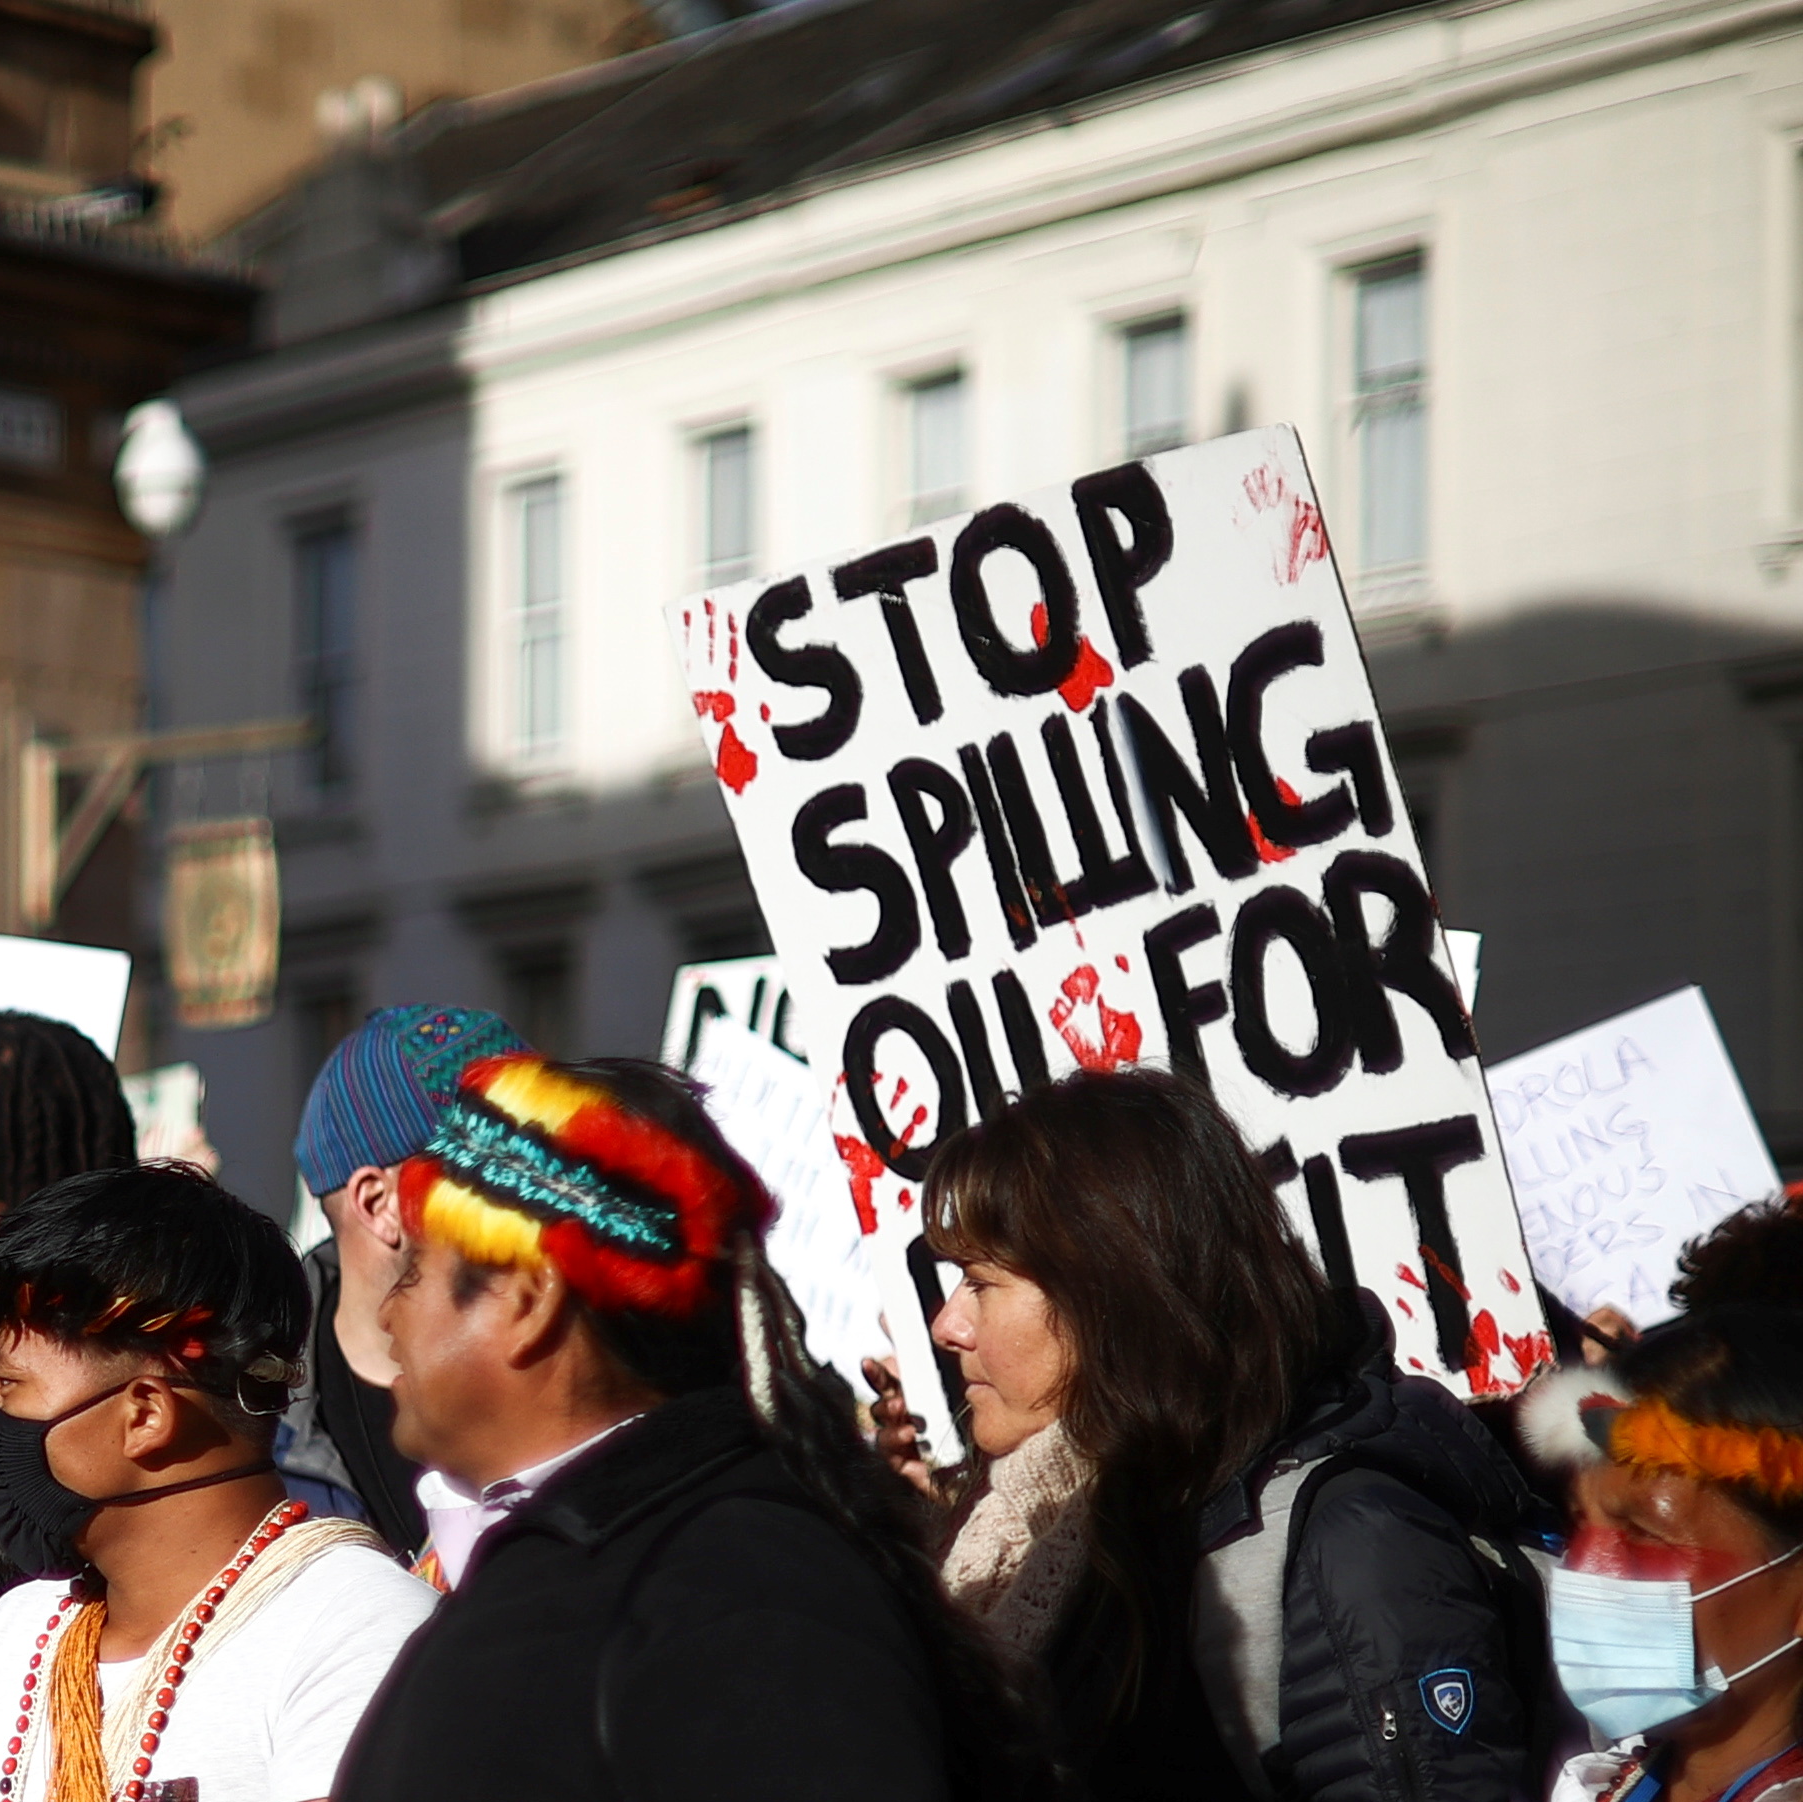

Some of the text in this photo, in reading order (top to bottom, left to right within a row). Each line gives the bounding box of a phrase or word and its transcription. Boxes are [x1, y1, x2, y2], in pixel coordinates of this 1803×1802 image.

[746, 461, 1173, 761] STOP
[791, 619, 1392, 985] SPILLING
[1145, 849, 1477, 1098] FOR
[1492, 1033, 1661, 1138] DROLA
